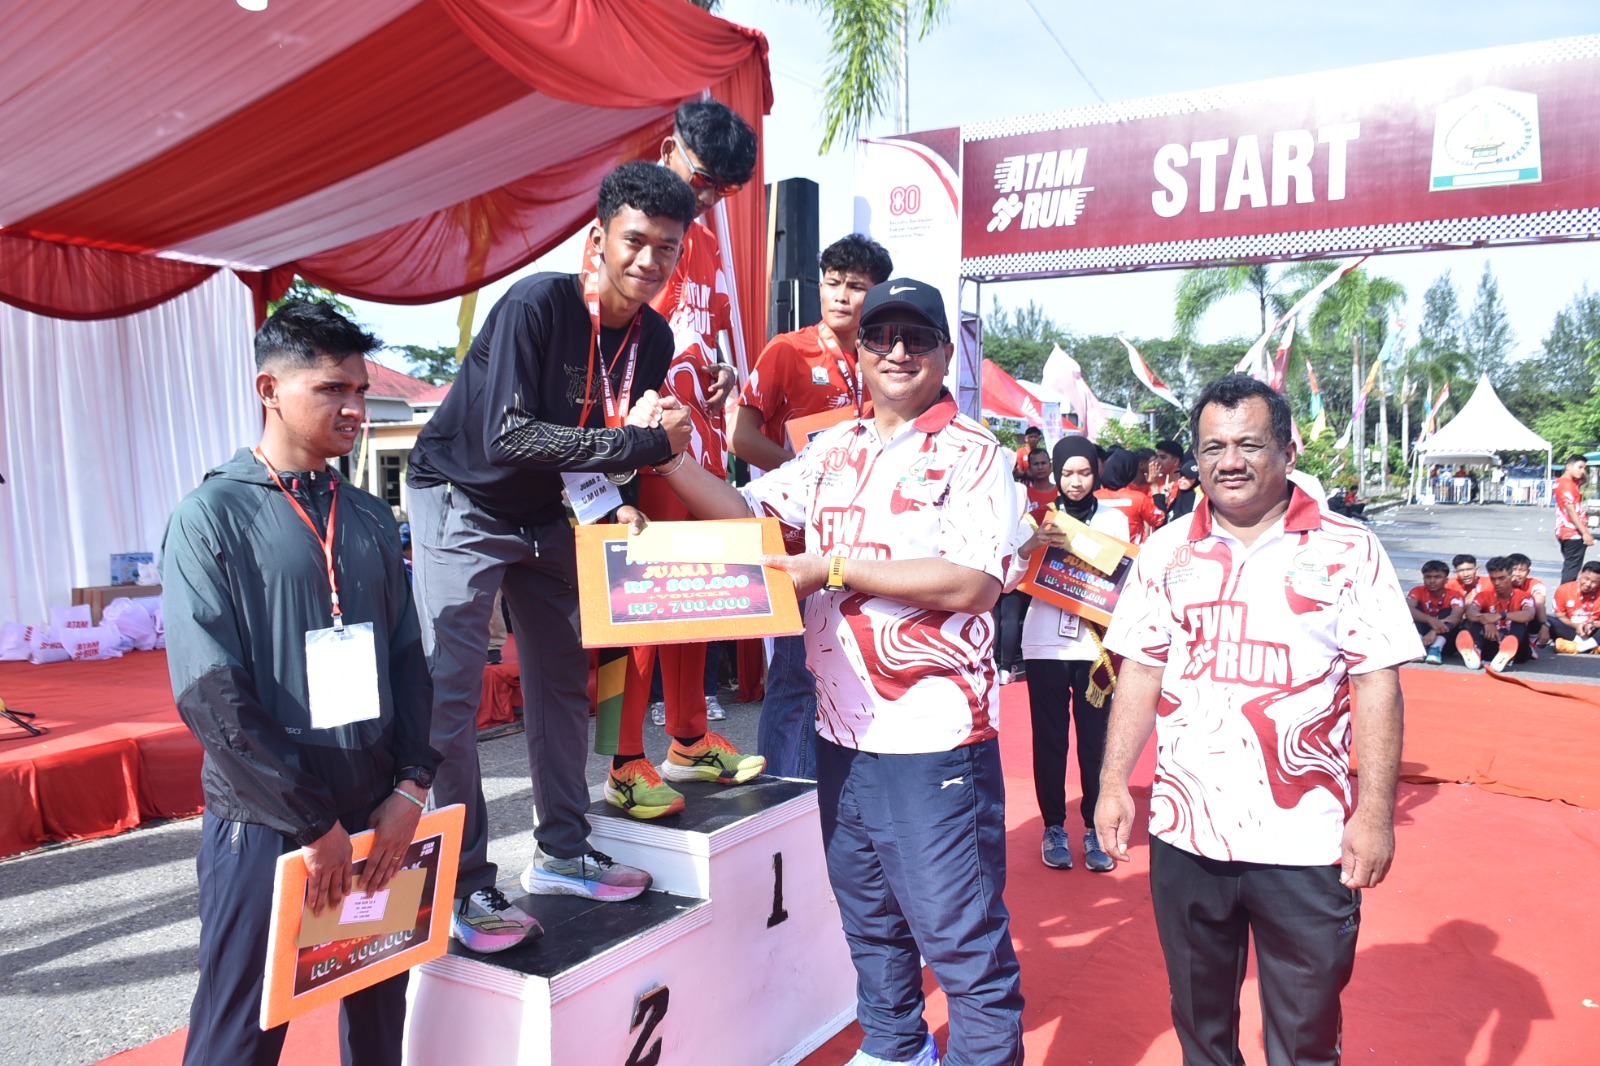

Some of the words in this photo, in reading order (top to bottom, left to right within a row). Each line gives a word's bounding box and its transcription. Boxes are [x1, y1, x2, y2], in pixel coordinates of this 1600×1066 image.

[995, 148, 1088, 193] ATAM
[1152, 122, 1361, 218] START
[890, 185, 921, 216] 80
[1020, 187, 1090, 230] RUN
[580, 478, 596, 491] JUARA
[582, 485, 607, 504] UMUM
[624, 580, 661, 594] RP.
[666, 574, 750, 592] 800.000
[642, 563, 710, 579] JUARA
[628, 602, 664, 616] RP.
[669, 596, 751, 614] 700.000
[1187, 604, 1243, 643] FUN
[1215, 640, 1289, 685] RUN
[767, 851, 789, 929] 1
[311, 956, 343, 980] RP.
[348, 929, 416, 964] 100.000
[625, 984, 670, 1066] 2
